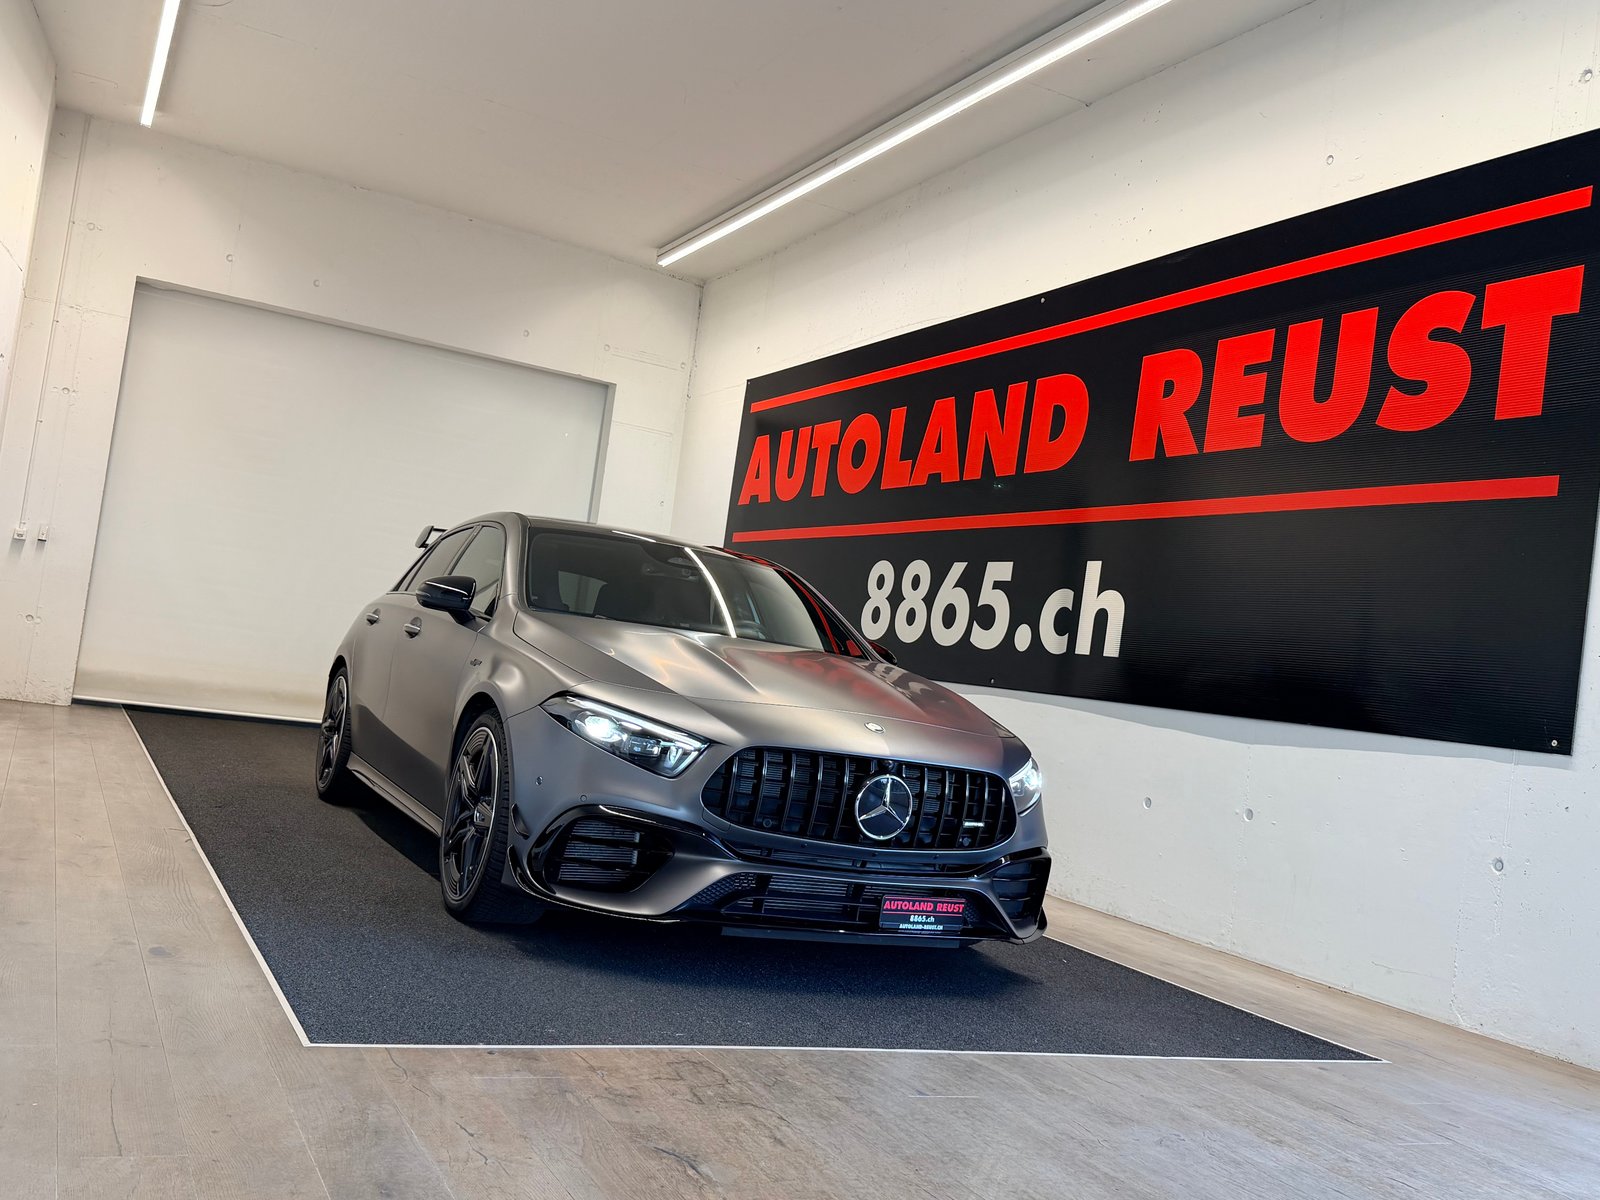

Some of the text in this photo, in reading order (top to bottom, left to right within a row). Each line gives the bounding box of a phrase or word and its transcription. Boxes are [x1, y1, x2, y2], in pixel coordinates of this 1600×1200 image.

[737, 264, 1585, 506] AUTOLAND REUST
[860, 559, 1126, 658] 8865.ch
[883, 900, 965, 912] AUTOLAND REUST
[909, 915, 935, 923] 8865.ch
